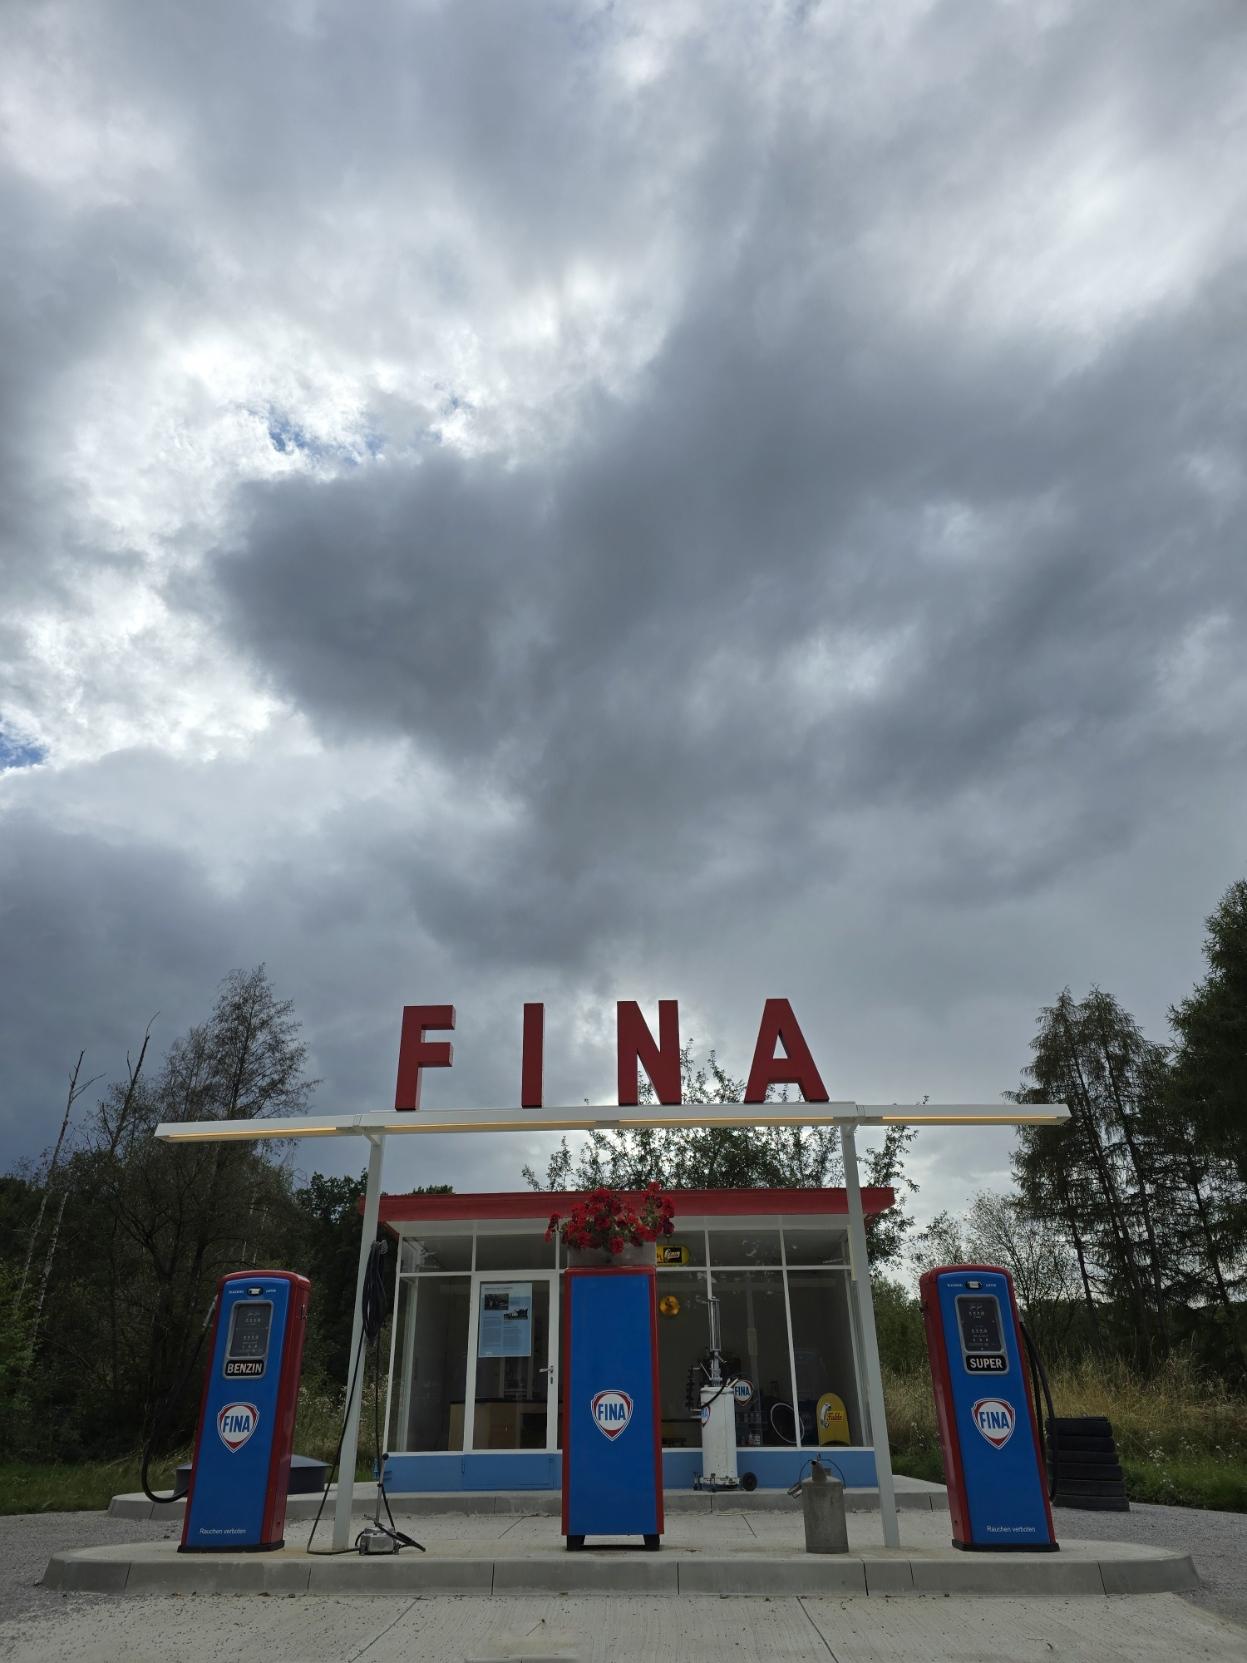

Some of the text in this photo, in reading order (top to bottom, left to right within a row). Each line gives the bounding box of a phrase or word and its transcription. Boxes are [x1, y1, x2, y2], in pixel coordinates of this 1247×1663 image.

[395, 998, 829, 1112] FINA
[227, 1363, 263, 1374] BENZIN
[969, 1358, 1003, 1369] SUPER
[734, 1385, 750, 1397] FINA
[597, 1403, 627, 1421] FINA
[222, 1415, 250, 1433] FINA
[978, 1411, 1010, 1429] FINA
[986, 1525, 1036, 1533] Rauchen verboten
